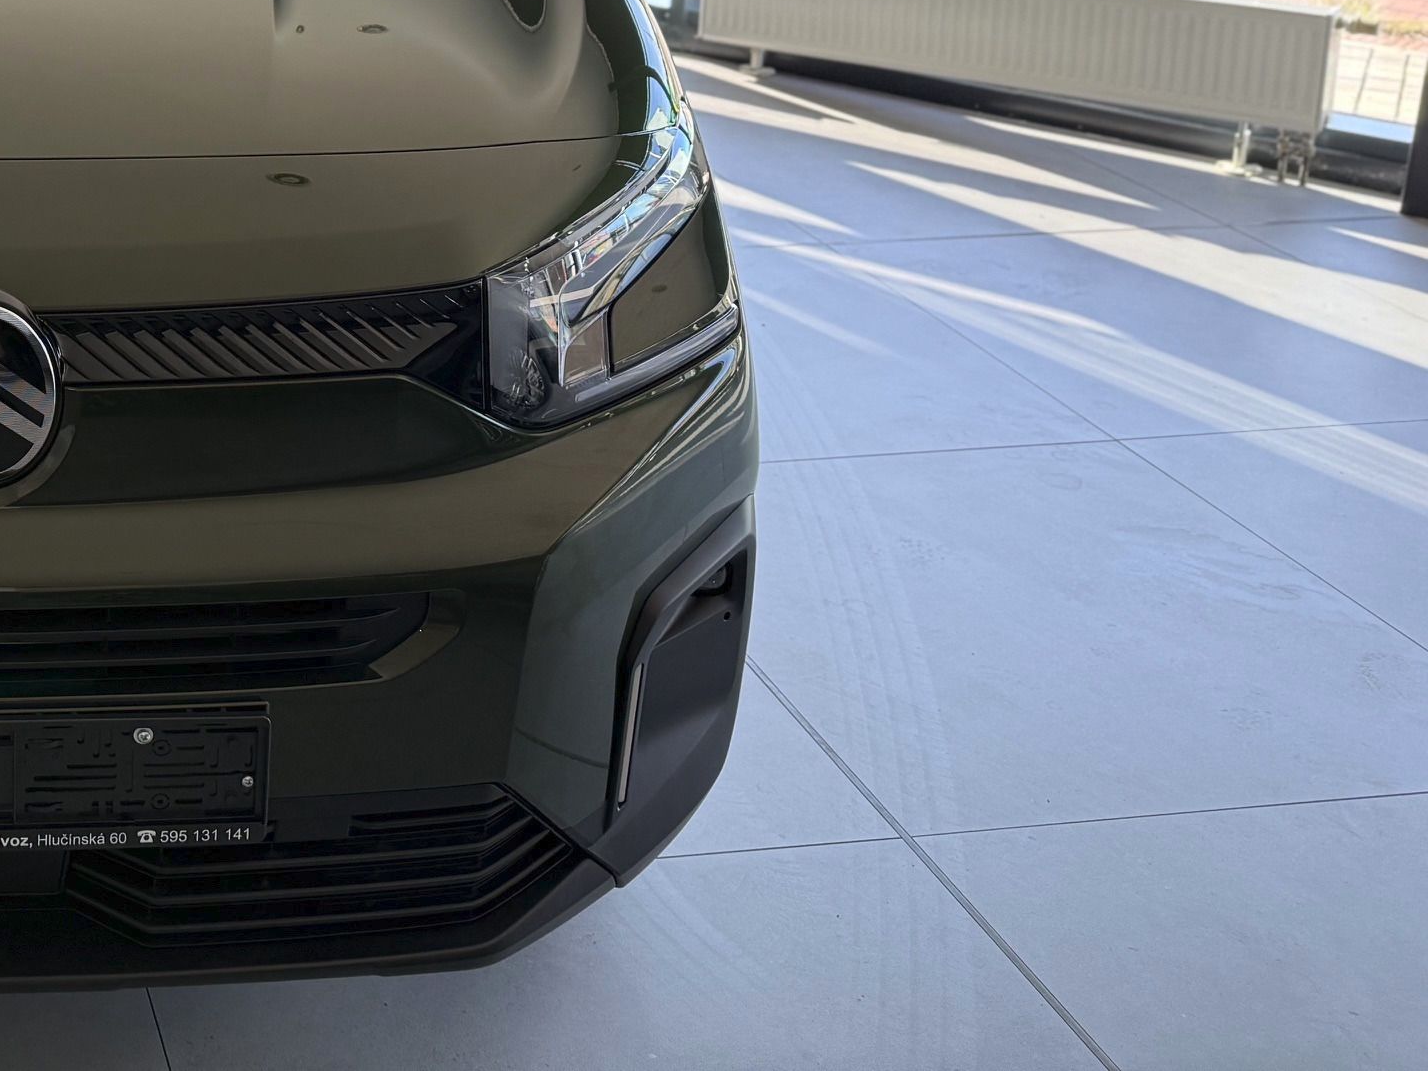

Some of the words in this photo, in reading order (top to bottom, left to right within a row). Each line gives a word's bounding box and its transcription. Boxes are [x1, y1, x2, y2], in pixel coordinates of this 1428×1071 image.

[37, 832, 106, 847] Hlučínská
[109, 832, 127, 845] 60
[160, 829, 188, 843] 595
[193, 828, 218, 842] 131
[225, 827, 250, 841] 141
